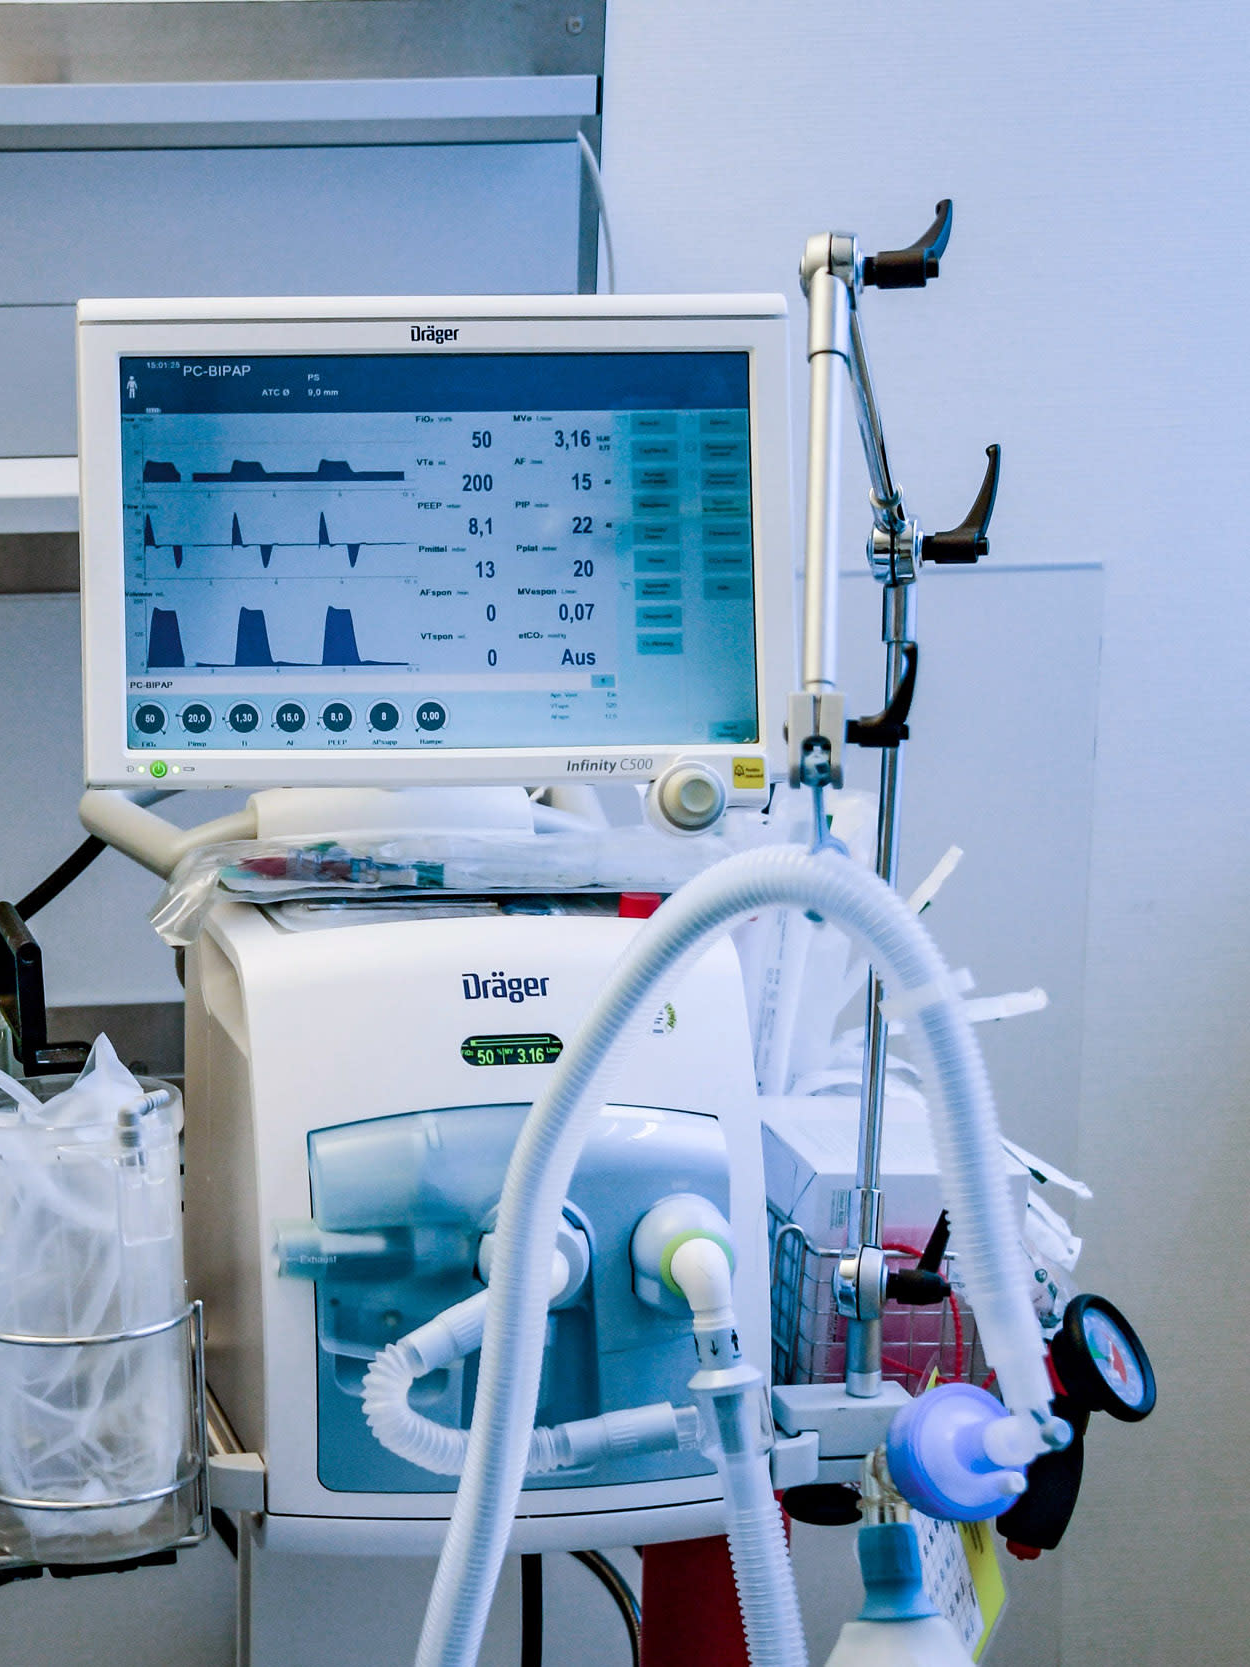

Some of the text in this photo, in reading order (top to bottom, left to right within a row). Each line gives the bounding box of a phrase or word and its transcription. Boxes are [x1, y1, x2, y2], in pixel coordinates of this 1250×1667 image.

[410, 325, 460, 344] Dräger
[183, 364, 251, 377] PC-BIPAP
[307, 373, 321, 382] PS
[262, 388, 281, 397] ATC
[307, 388, 321, 398] 9,0
[513, 414, 532, 422] MVe
[472, 430, 492, 449] 50
[554, 429, 591, 451] 3,16
[416, 458, 434, 466] VTe
[514, 457, 526, 465] AF
[462, 474, 493, 492] 200
[571, 473, 592, 491] 15
[417, 501, 442, 510] PEEP
[515, 501, 530, 509] PIP
[468, 517, 493, 538] 8,1
[572, 516, 593, 534] 22
[418, 545, 448, 553] Pmittel
[516, 544, 538, 553] Pplat
[475, 560, 495, 578] 13
[573, 559, 594, 577] 20
[419, 589, 452, 597] AFspon
[517, 588, 557, 597] MVespon
[486, 604, 496, 622] 0
[558, 603, 595, 624] 0,07
[420, 632, 454, 642] VTspon
[487, 649, 497, 667] 0
[561, 648, 596, 666] Aus
[129, 681, 173, 689] PC-BIPAP
[145, 713, 156, 723] 50
[188, 713, 206, 724] 20,0
[235, 713, 253, 724] 1,30
[281, 712, 300, 723] 15,0
[330, 712, 344, 722] 8,0
[381, 712, 387, 721] 8
[421, 712, 440, 722] 0,00
[566, 758, 654, 774] Infinity C500
[461, 971, 550, 1003] Dräger
[477, 1049, 495, 1064] 50
[517, 1047, 545, 1064] 3.16
[300, 1255, 337, 1264] Exhaust
